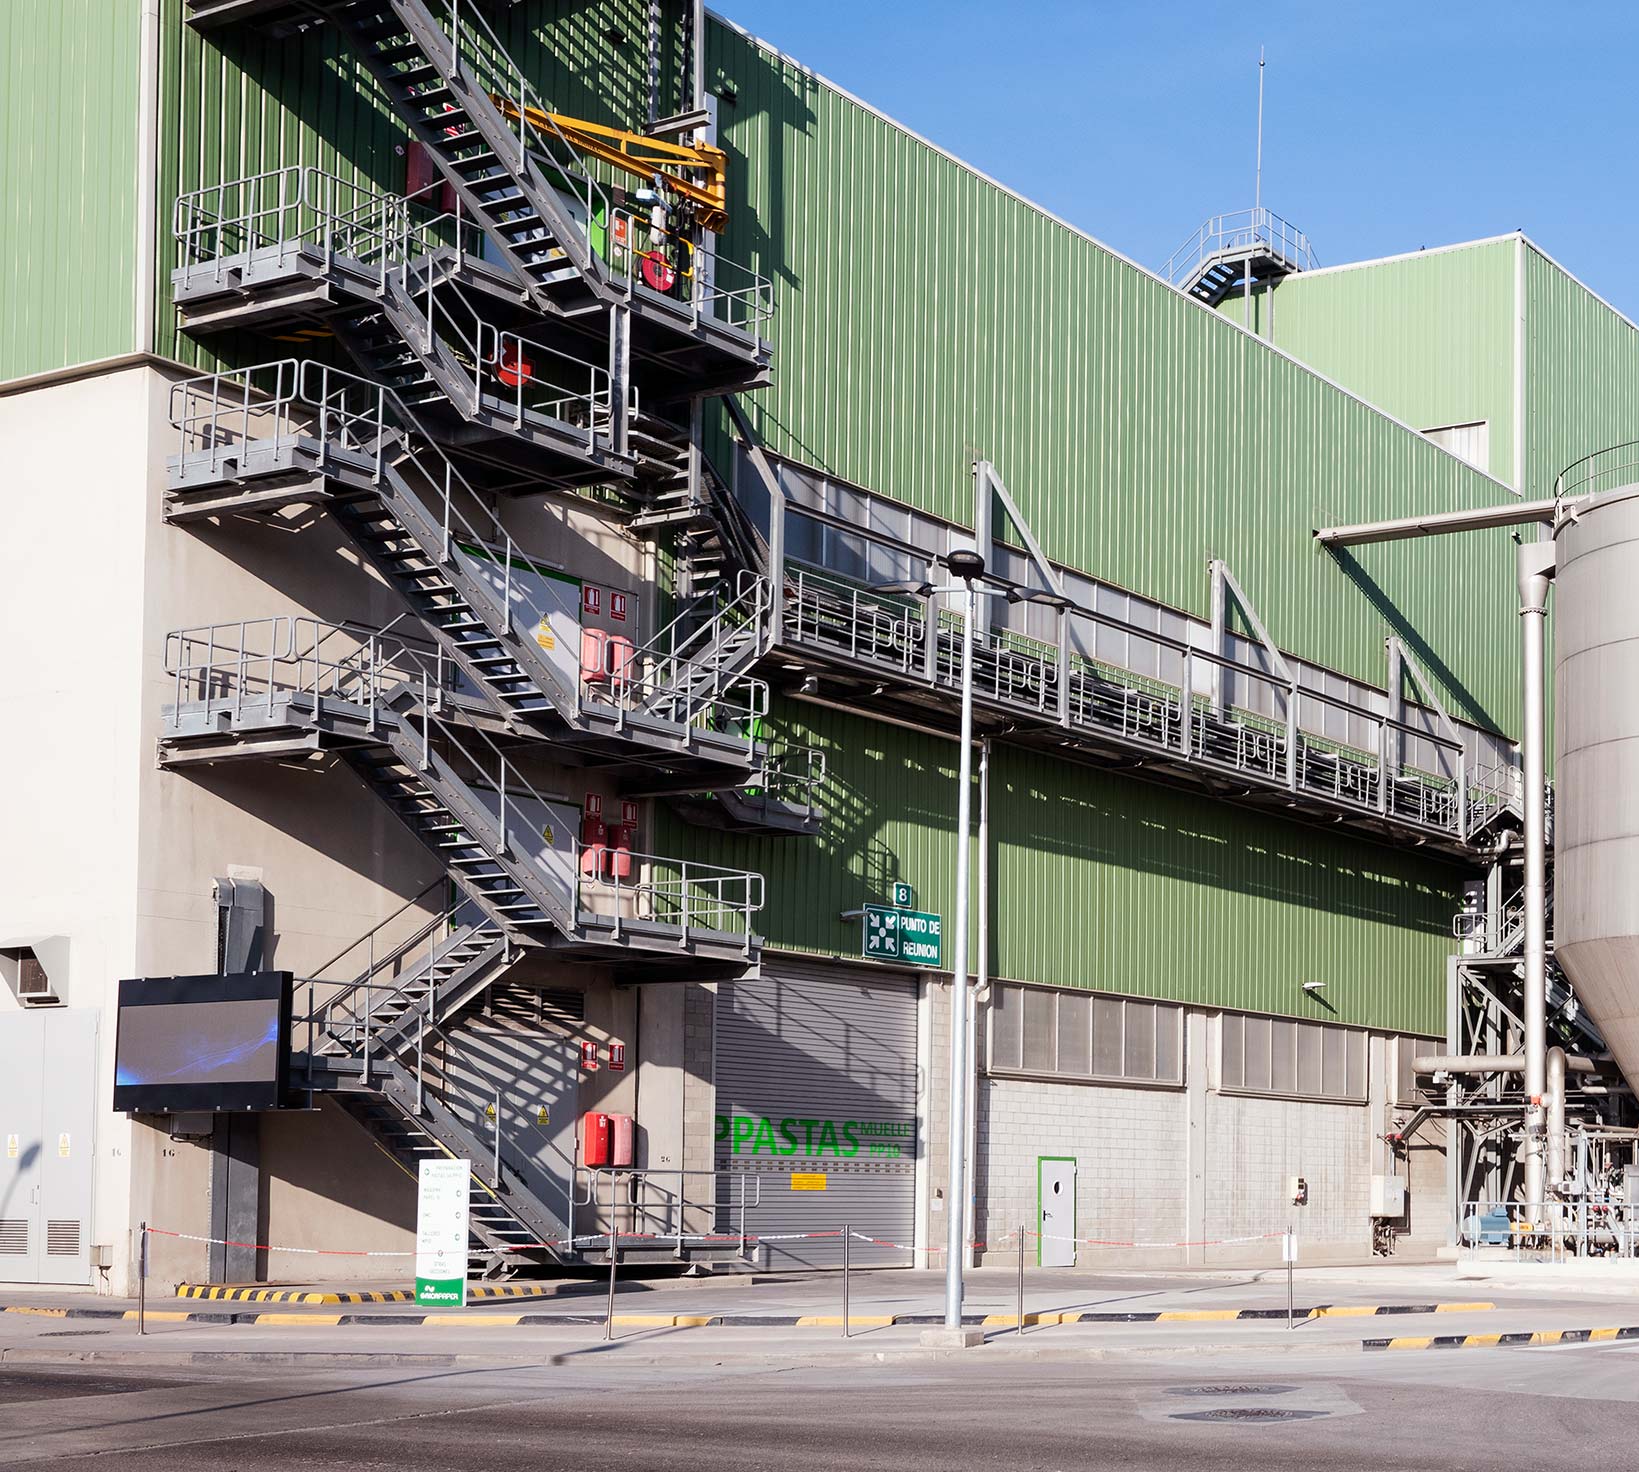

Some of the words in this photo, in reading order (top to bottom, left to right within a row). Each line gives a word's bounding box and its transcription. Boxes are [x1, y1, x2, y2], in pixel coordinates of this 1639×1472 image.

[899, 888, 907, 901] 8
[901, 917, 926, 933] PUNTO
[929, 921, 939, 934] DE
[903, 942, 937, 958] REUNION
